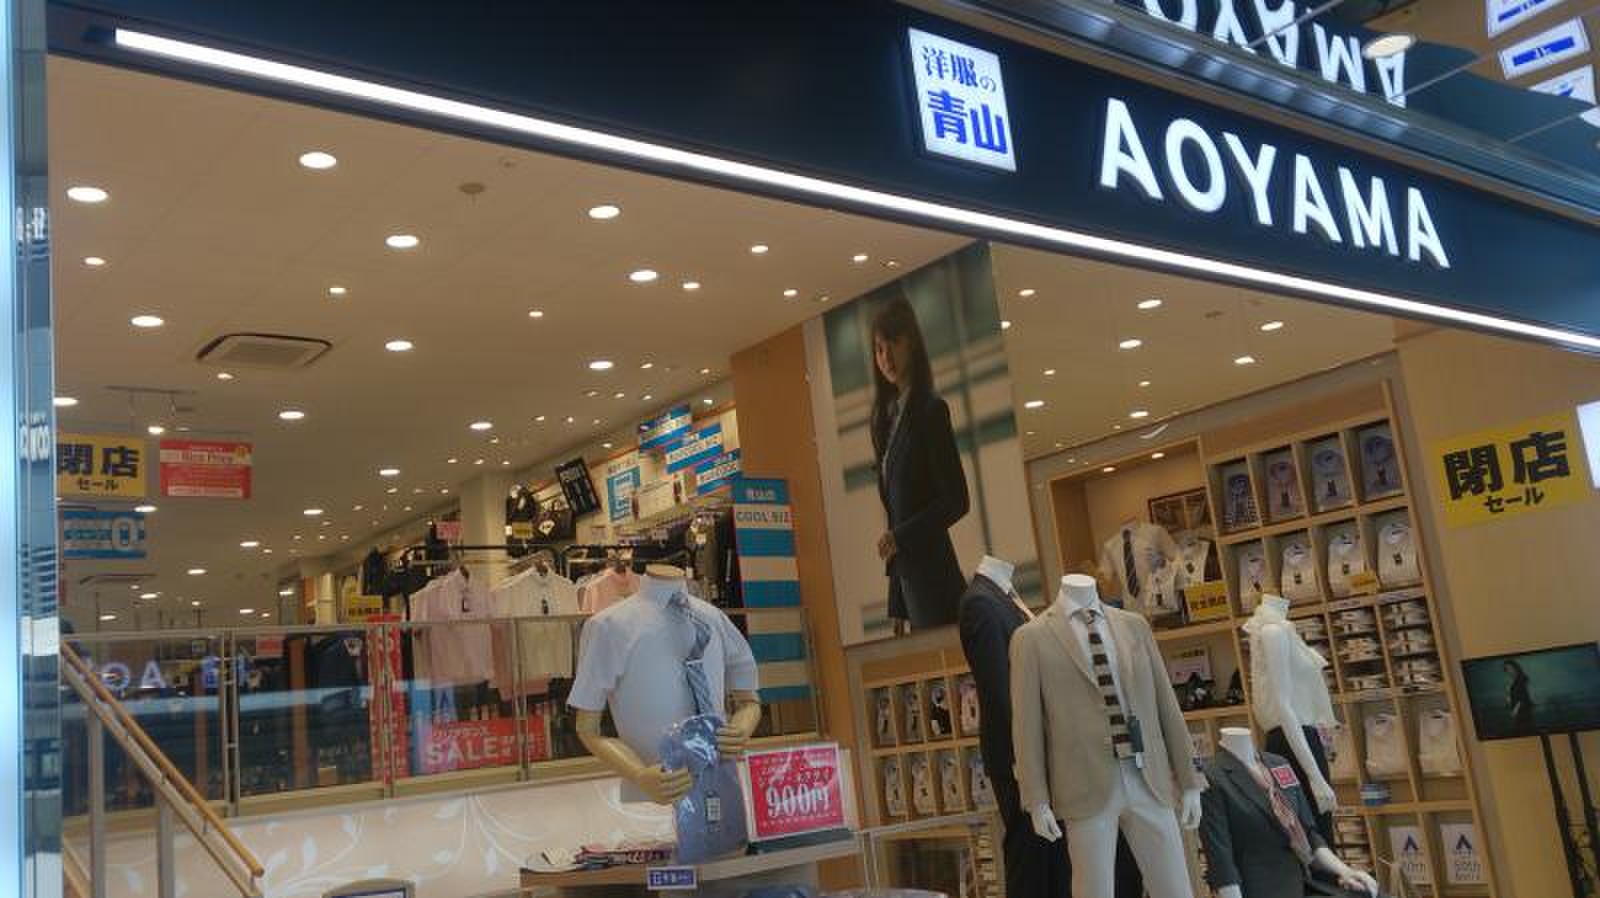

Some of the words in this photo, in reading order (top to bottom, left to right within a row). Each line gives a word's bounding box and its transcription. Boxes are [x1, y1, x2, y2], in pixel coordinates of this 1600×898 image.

[921, 45, 997, 93] 洋服の
[927, 89, 1009, 155] 青山
[1100, 97, 1450, 269] AOYAMA
[57, 443, 140, 478] 閉店
[1443, 430, 1570, 501] 閉店
[77, 478, 119, 491] セール
[1483, 487, 1545, 513] セール
[426, 735, 497, 765] SALE
